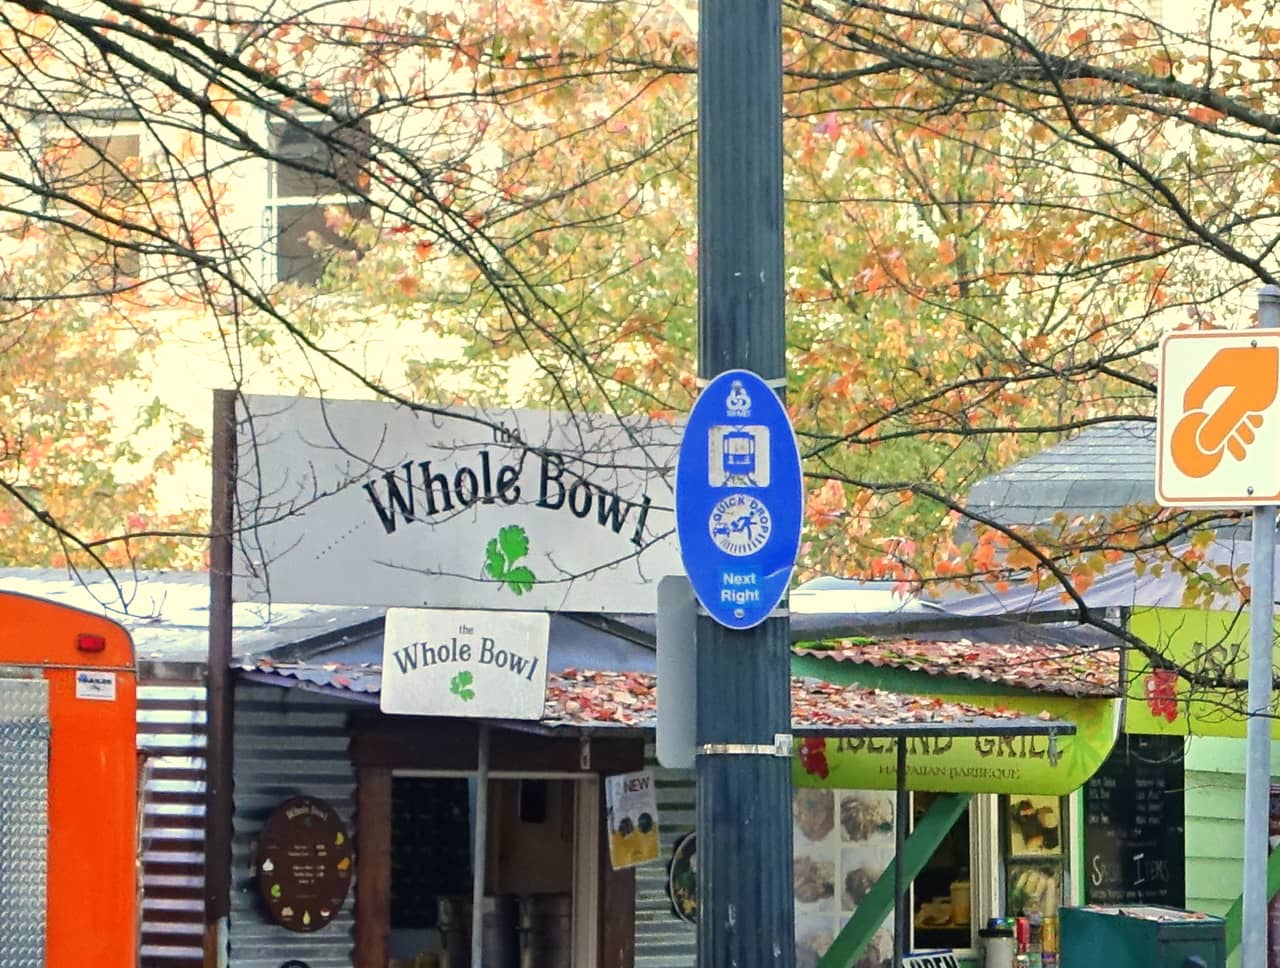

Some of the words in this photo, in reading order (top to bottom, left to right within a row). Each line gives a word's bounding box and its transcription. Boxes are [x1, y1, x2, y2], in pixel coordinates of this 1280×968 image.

[361, 450, 522, 535] Whole
[535, 450, 651, 548] Bowl
[713, 496, 746, 522] QUICK
[750, 500, 769, 534] DROP
[723, 572, 757, 585] Next
[720, 589, 760, 603] Right
[458, 624, 475, 635] the
[392, 637, 473, 675] Whole
[478, 637, 540, 682] Bowl
[623, 777, 650, 793] NEW
